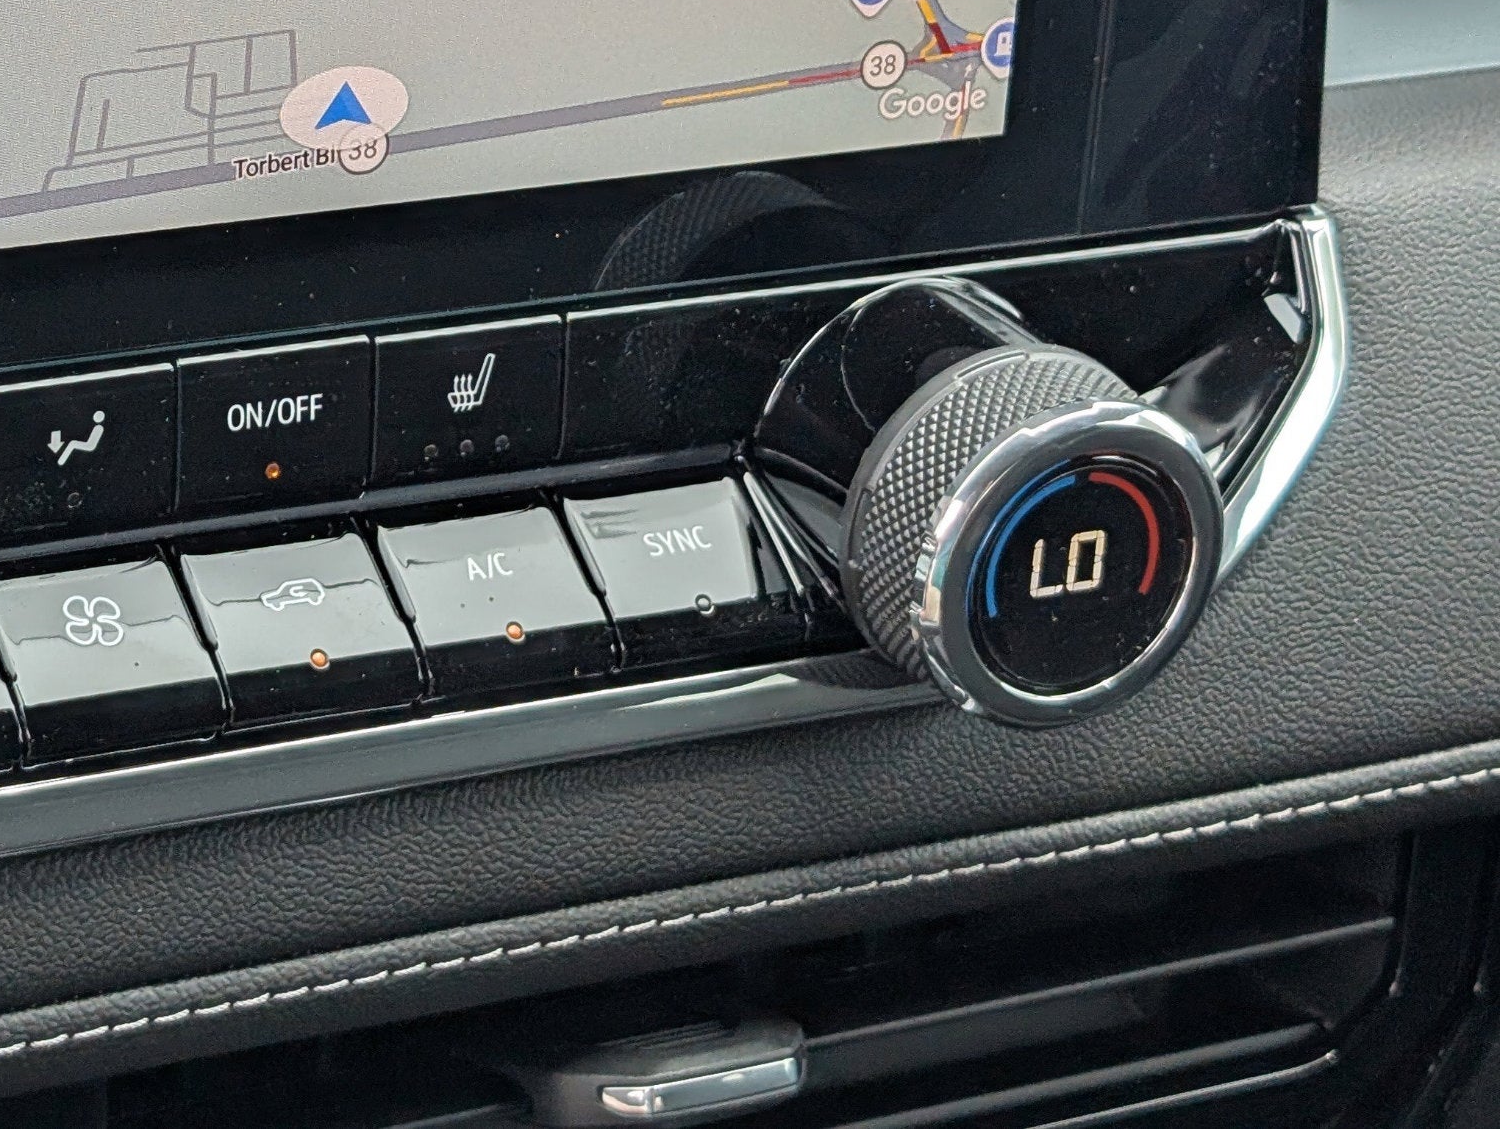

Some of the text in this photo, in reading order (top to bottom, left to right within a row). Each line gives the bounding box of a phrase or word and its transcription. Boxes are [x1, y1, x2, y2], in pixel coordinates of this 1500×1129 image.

[869, 54, 897, 76] 38
[879, 88, 987, 120] Google
[348, 137, 378, 161] 38
[233, 153, 311, 180] Torbert
[227, 393, 323, 432] ON/OFF
[642, 524, 713, 558] SYNC
[465, 551, 514, 582] A/C
[1029, 529, 1108, 600] LO
